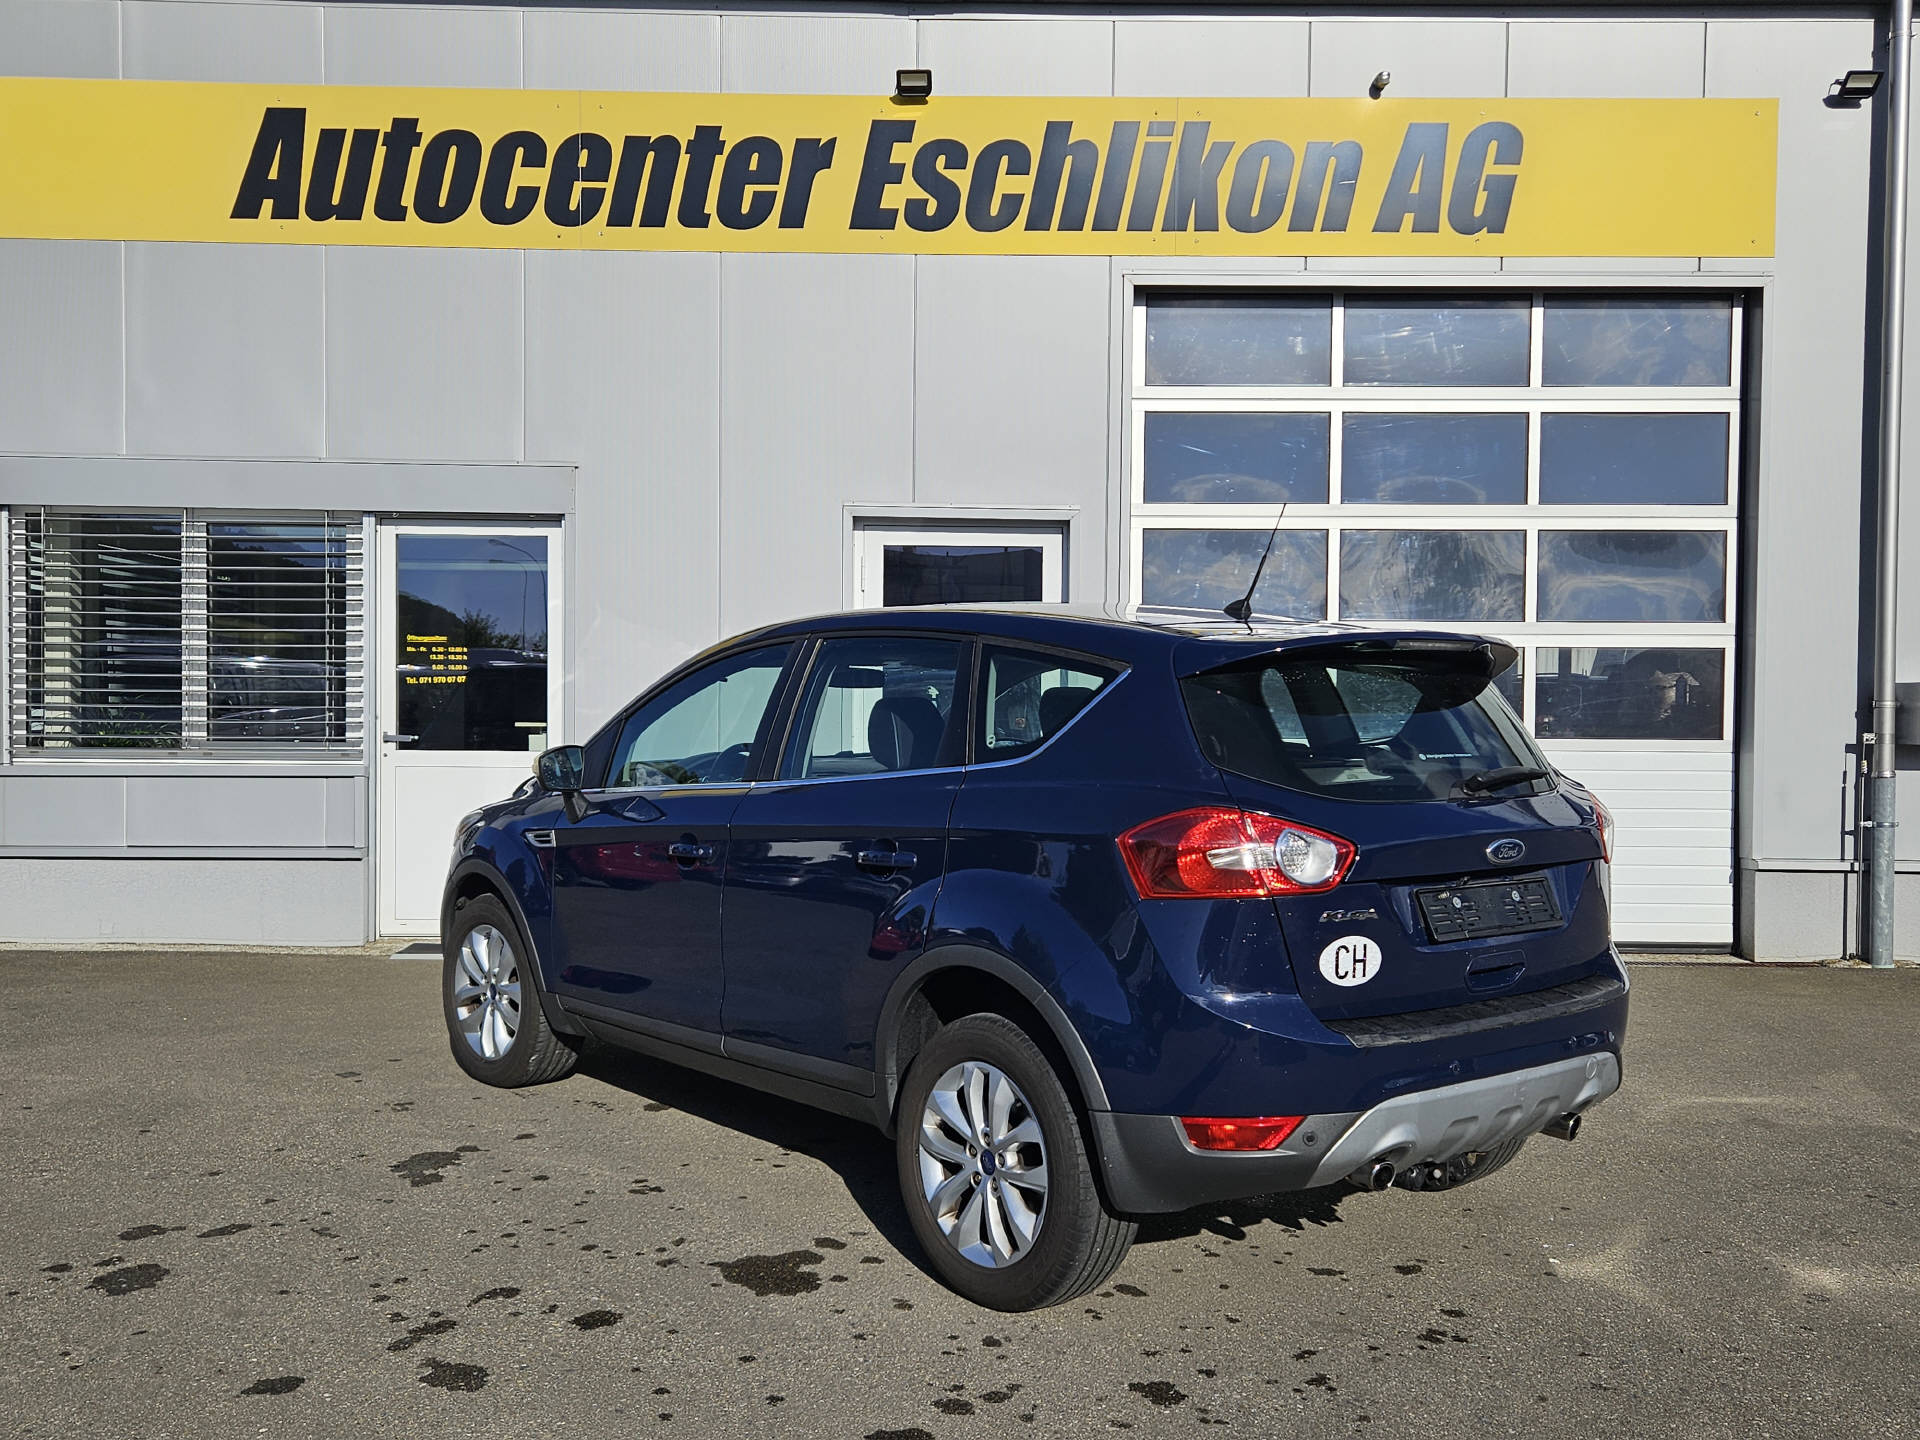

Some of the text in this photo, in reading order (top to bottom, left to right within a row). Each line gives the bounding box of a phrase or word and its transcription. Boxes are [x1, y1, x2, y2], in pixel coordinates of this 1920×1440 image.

[230, 107, 1524, 235] Autocenter Eschlikon AG
[419, 676, 432, 684] 071
[456, 675, 467, 683] 07
[1335, 944, 1368, 980] CH
